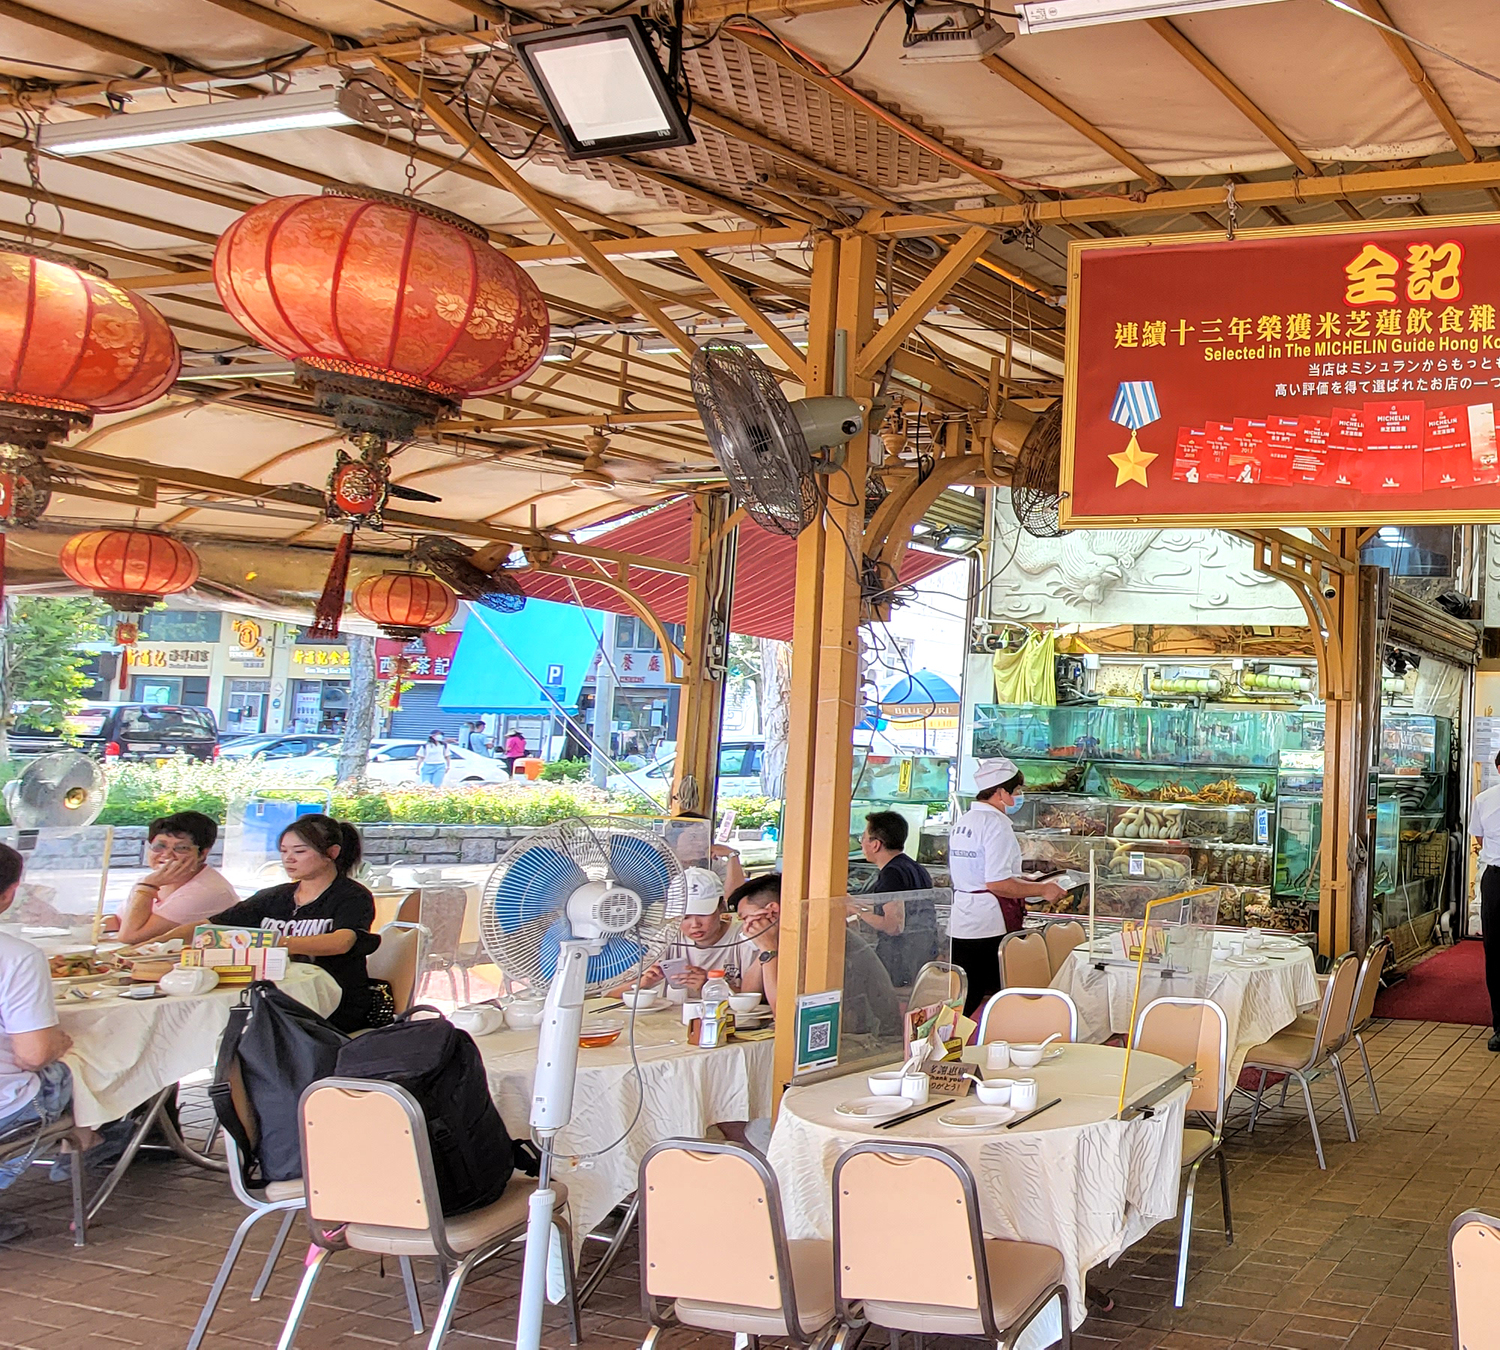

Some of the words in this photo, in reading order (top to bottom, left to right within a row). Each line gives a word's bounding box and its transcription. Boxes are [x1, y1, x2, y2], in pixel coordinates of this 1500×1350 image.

[1343, 242, 1464, 306] 全記
[1204, 345, 1265, 362] Selected
[1268, 343, 1282, 360] in
[1285, 342, 1311, 358] The
[1315, 339, 1387, 357] MICHELIN
[1391, 337, 1436, 354] Guide
[1440, 335, 1479, 354] Hong
[379, 655, 451, 676] 西茶記
[548, 666, 561, 684] P
